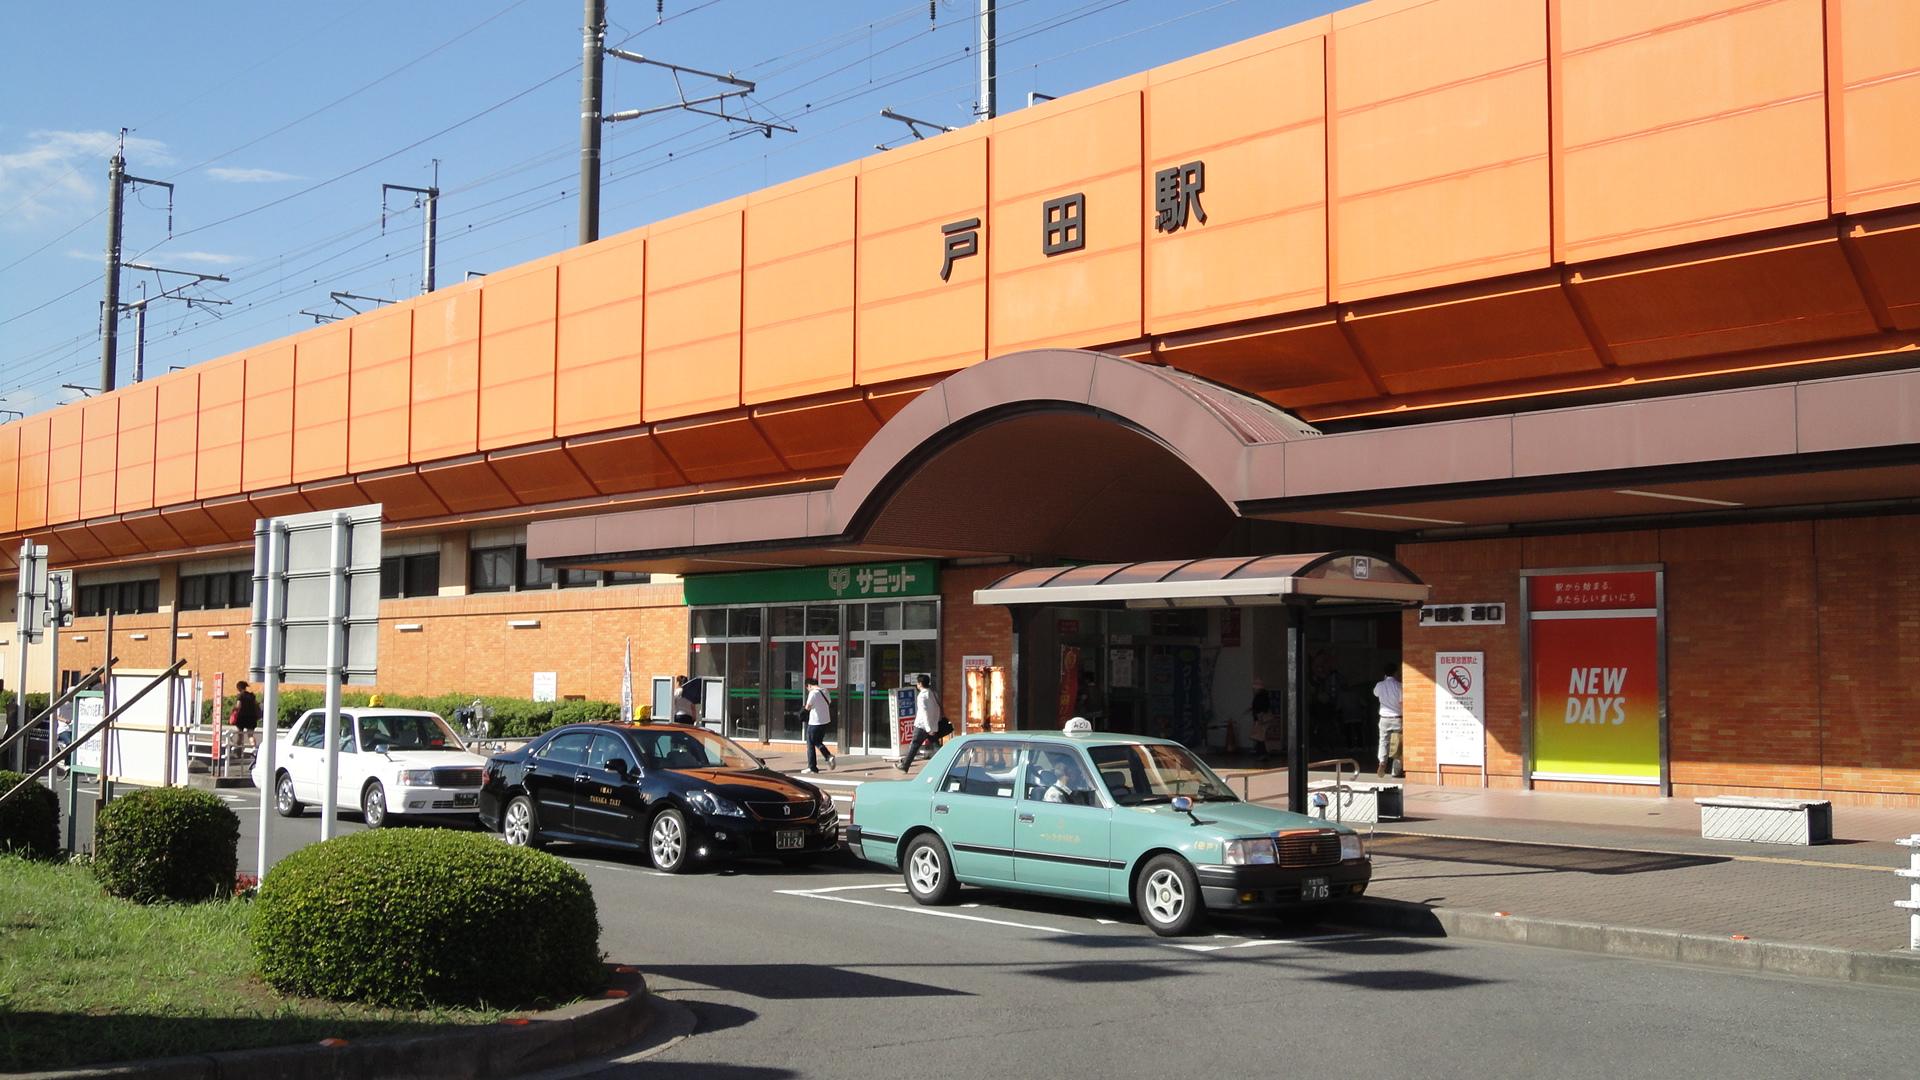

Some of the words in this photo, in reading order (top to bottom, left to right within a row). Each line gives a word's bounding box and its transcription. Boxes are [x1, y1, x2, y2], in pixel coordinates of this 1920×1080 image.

[940, 160, 1208, 282] 戸田駅
[856, 566, 916, 594] サミット
[1555, 592, 1637, 604] あたらしいまいにち
[1420, 607, 1464, 622] 戸田駅
[1471, 606, 1502, 621] 西口
[810, 641, 840, 689] 酒
[1569, 667, 1628, 694] NEW
[1564, 697, 1626, 725] DAYS
